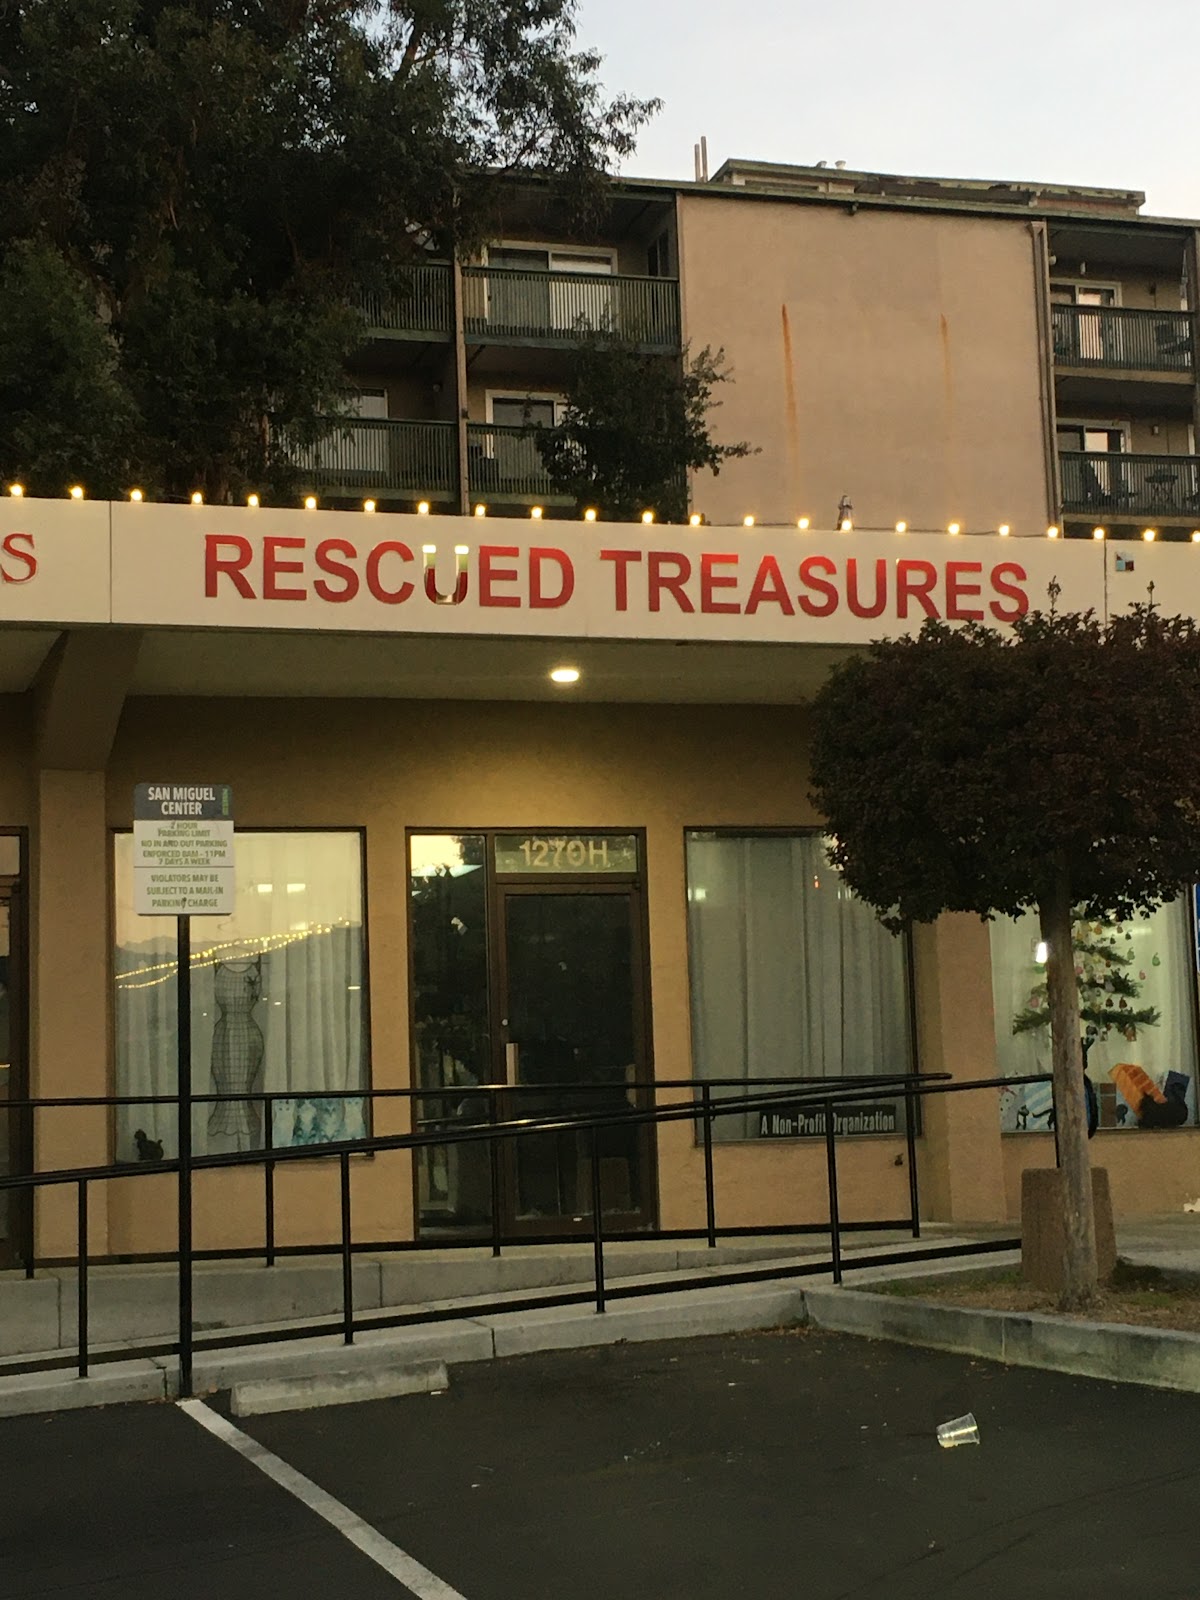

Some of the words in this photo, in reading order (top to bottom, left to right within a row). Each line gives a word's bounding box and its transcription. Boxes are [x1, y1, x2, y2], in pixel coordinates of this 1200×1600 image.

[205, 534, 575, 609] RESCUED
[600, 549, 1029, 622] TREASURES
[148, 787, 172, 800] SAN
[173, 787, 215, 801] MIGUEL
[161, 802, 202, 815] CENTER
[158, 829, 190, 837] PARKING
[519, 840, 608, 867] 1270H
[151, 874, 191, 882] VIOLATORS
[192, 874, 208, 882] MAY
[209, 874, 219, 882] BE
[147, 886, 177, 895] SUBJECT
[178, 886, 188, 894] TO
[189, 886, 194, 894] A
[195, 886, 224, 894] MAIL-IN
[152, 899, 186, 907] PARKING
[187, 899, 218, 907] CHARGE
[761, 1115, 768, 1135] A
[772, 1113, 826, 1134] Non-Profit
